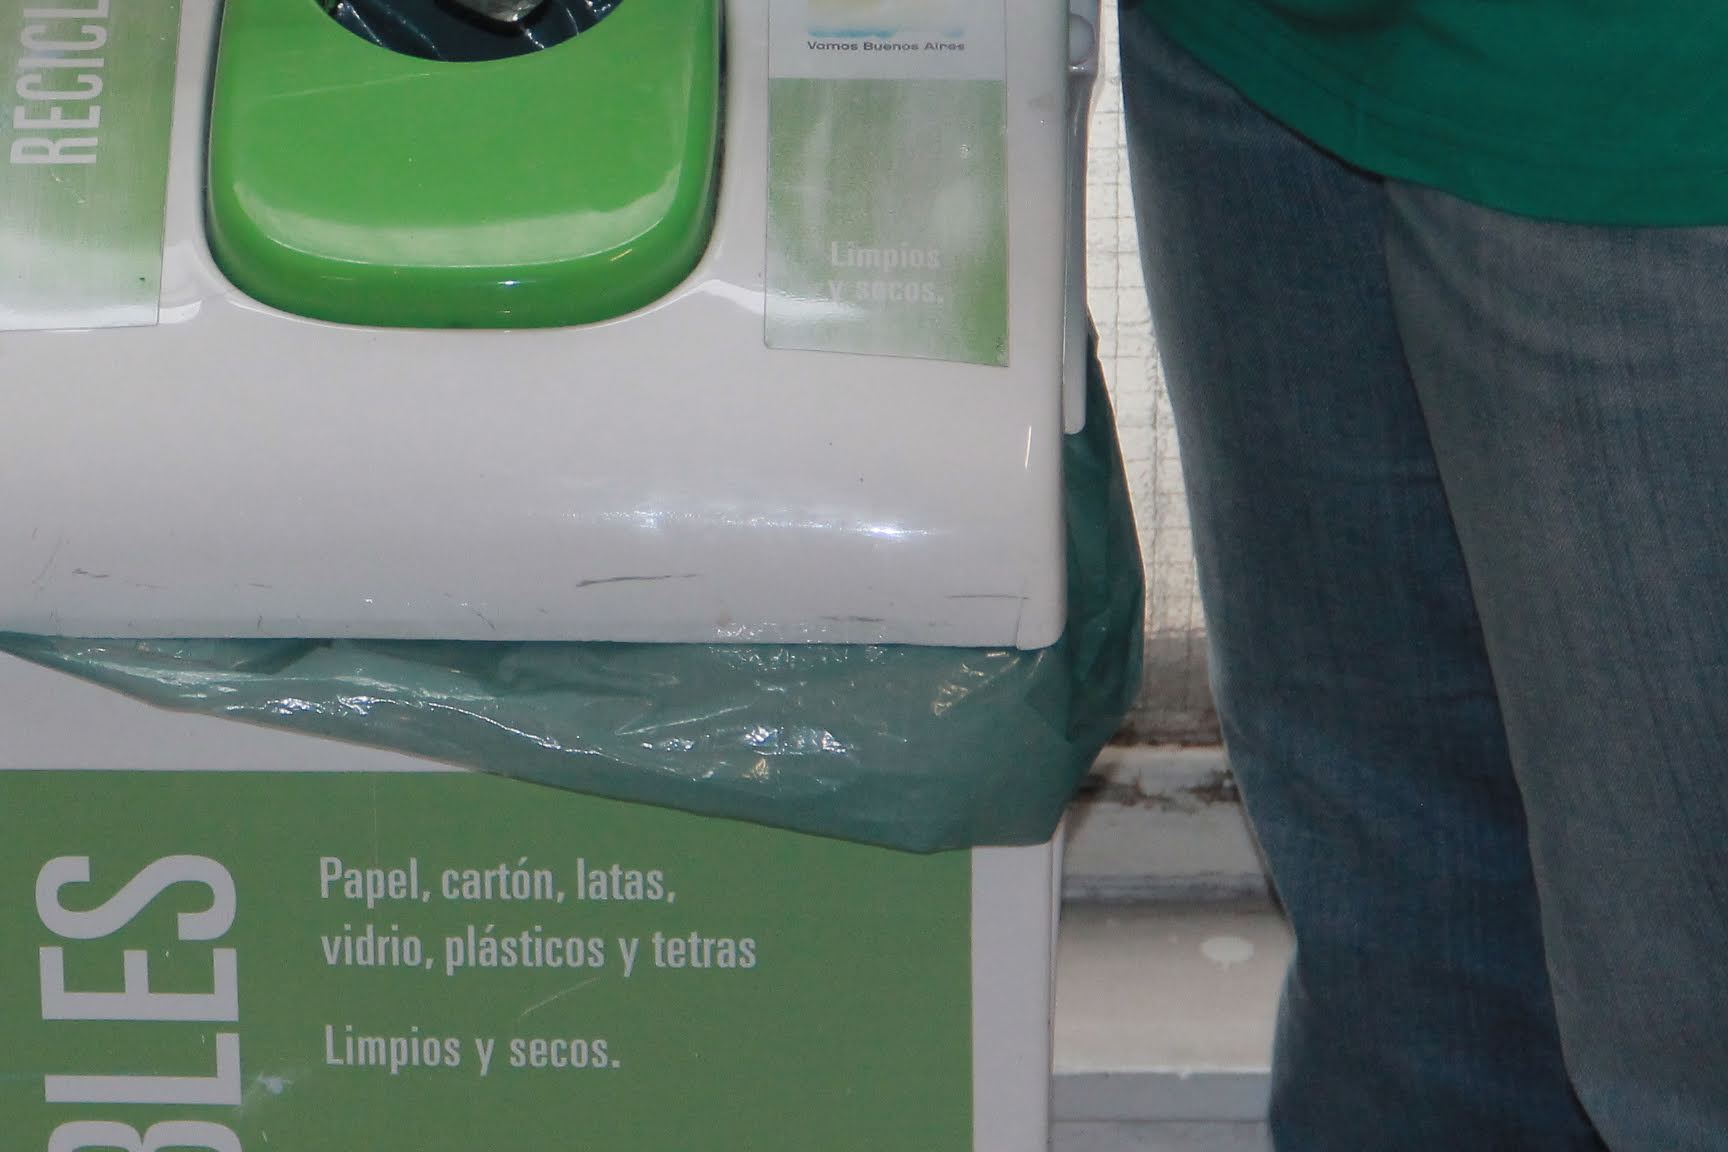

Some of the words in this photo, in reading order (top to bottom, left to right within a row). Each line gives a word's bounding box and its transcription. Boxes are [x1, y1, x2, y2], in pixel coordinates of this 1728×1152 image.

[807, 40, 859, 52] Vamos
[863, 40, 919, 51] Buenos
[924, 41, 965, 51] Aires
[319, 856, 431, 909] Papel,
[441, 856, 565, 904] cartón,
[576, 858, 677, 904] latas,
[321, 923, 433, 970] vidrio,
[445, 923, 605, 976] plásticos
[618, 937, 640, 978] y
[652, 931, 757, 969] tetras
[325, 1024, 461, 1075] Limpios
[475, 1038, 495, 1076] y
[509, 1038, 621, 1068] secos.
